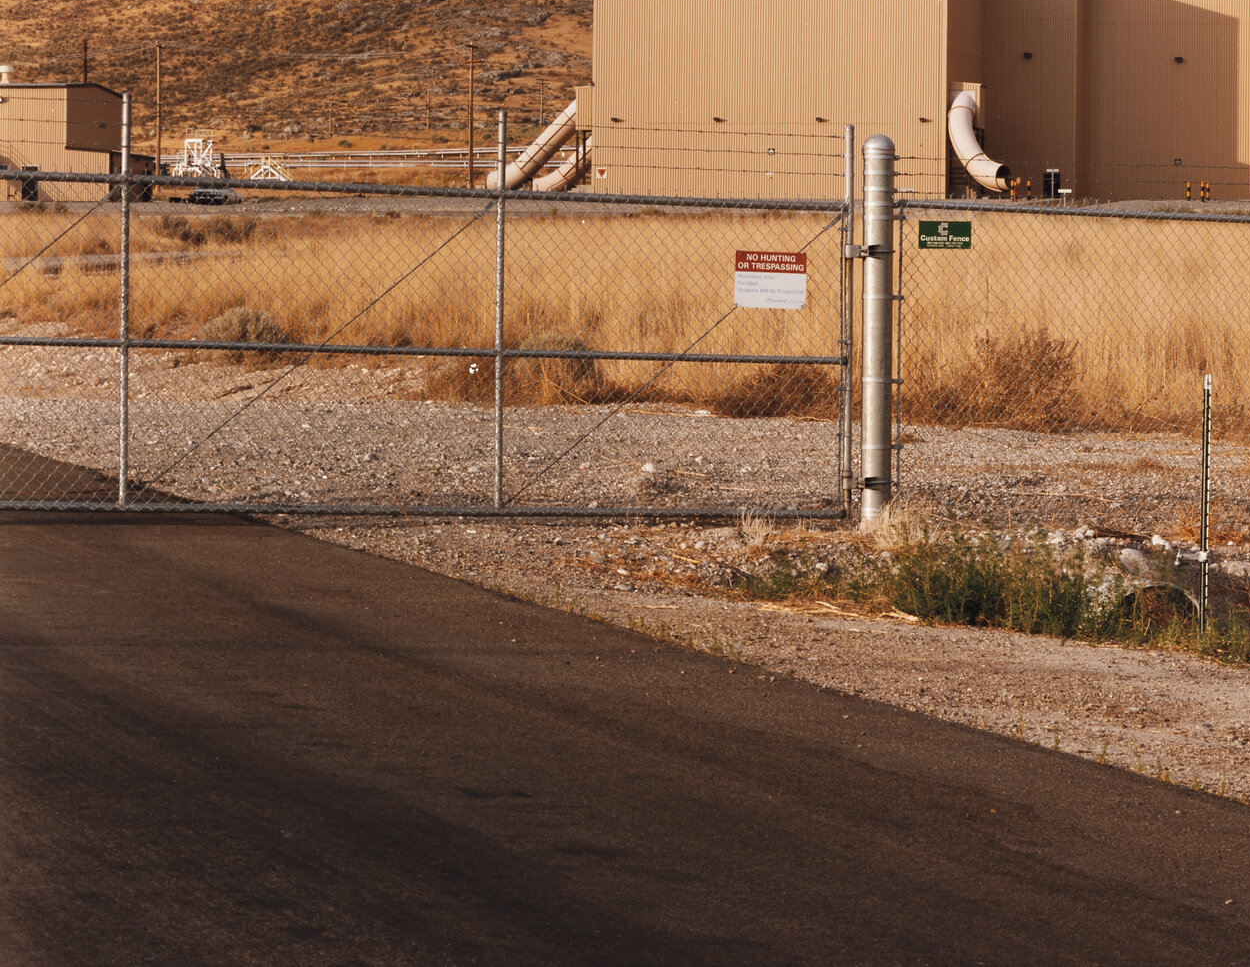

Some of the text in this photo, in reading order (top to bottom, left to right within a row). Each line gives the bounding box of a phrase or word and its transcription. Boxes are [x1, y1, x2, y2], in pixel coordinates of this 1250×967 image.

[746, 253, 796, 263] NO HUNTING
[737, 261, 804, 271] OR TRESPASSING
